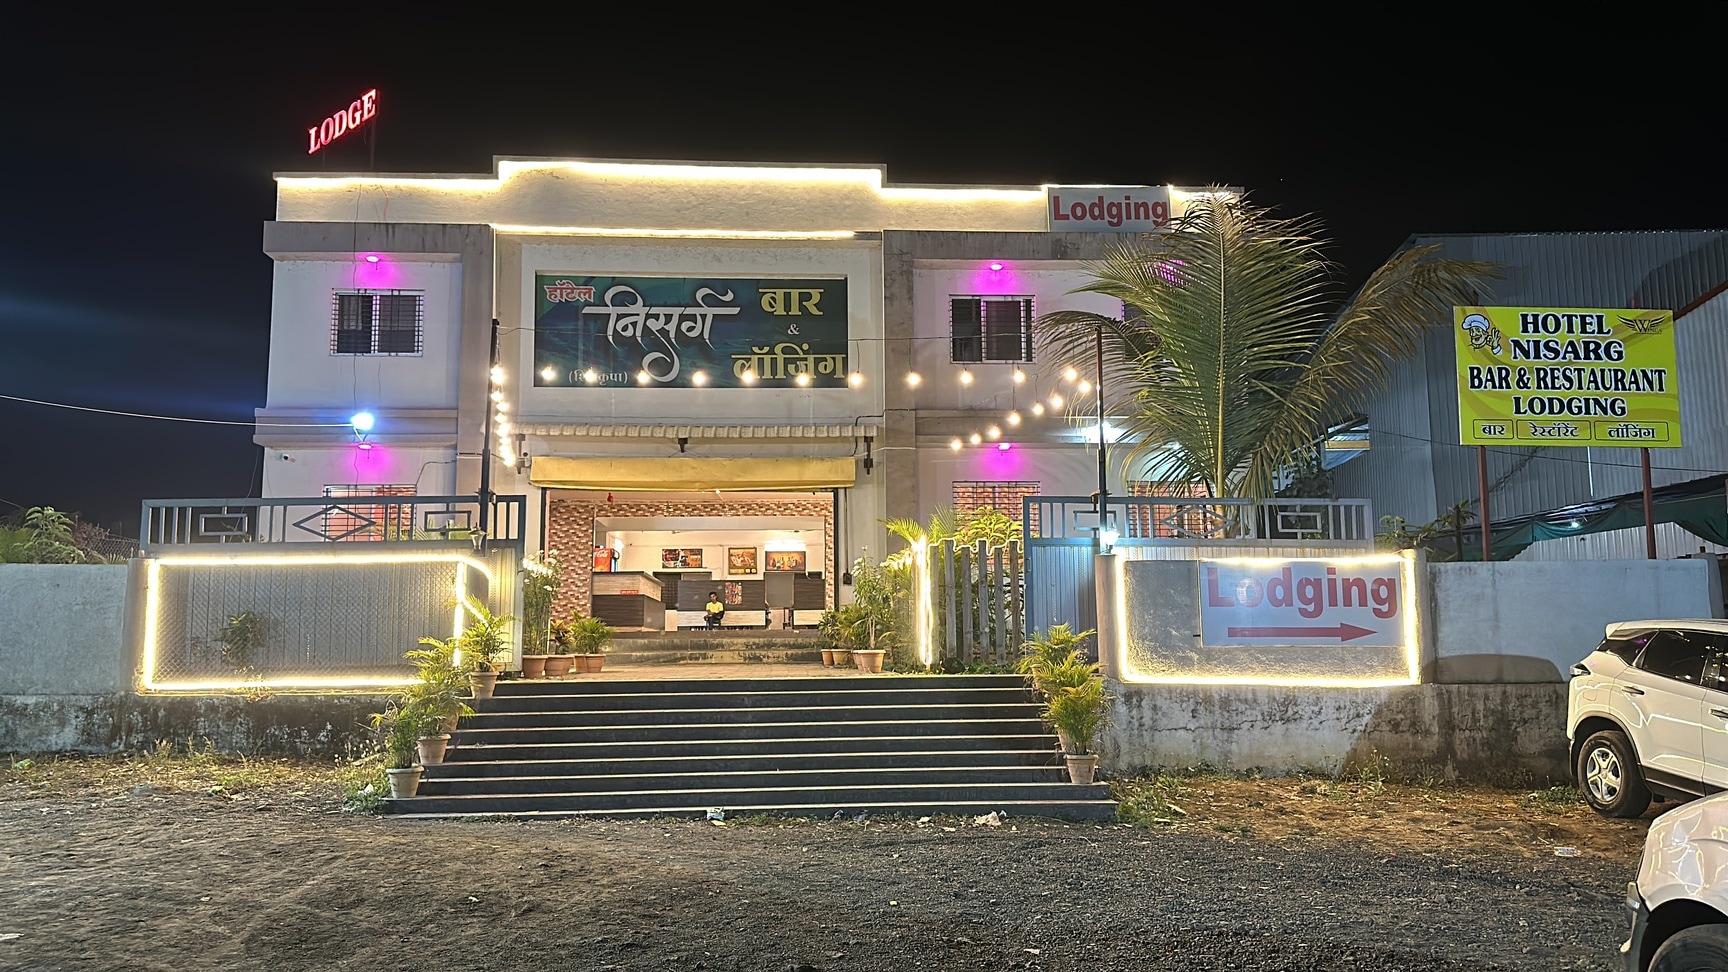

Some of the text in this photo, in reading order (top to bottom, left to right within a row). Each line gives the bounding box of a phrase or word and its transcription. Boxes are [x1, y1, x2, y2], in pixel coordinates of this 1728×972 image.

[308, 88, 376, 154] LODGE
[1053, 195, 1169, 227] Lodging
[544, 280, 595, 302] हॉटेल
[759, 288, 824, 316] बार
[787, 323, 800, 335] &
[1520, 313, 1612, 335] HOTEL
[731, 343, 846, 379] लॉजिंग
[1510, 339, 1625, 362] NISARG
[1468, 366, 1667, 392] BAR & RESTAURANT
[1512, 396, 1627, 417] LODGING
[1481, 424, 1506, 436] बार
[1607, 423, 1656, 438] लॉजिंग
[1207, 567, 1398, 619] Lodging
